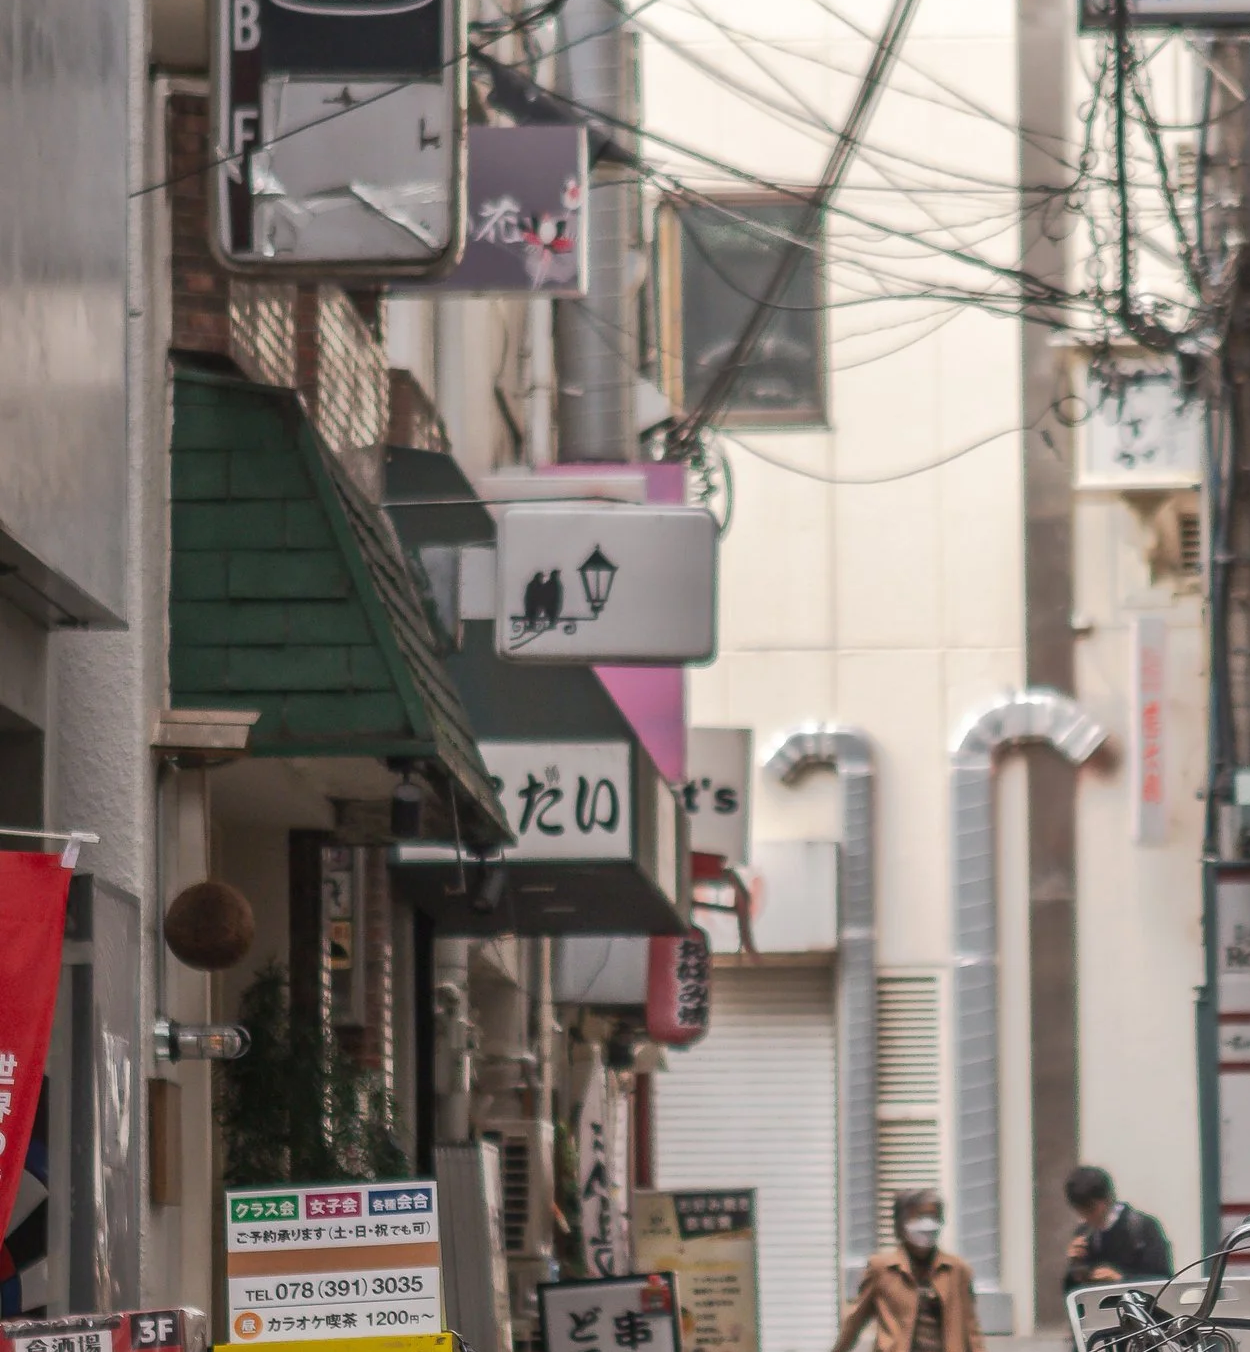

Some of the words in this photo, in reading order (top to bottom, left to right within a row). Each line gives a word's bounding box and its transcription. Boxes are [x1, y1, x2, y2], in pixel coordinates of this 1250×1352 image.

[235, 1200, 295, 1219] クラス会
[309, 1197, 358, 1216] 女子会
[372, 1193, 429, 1213] 各種会合
[246, 1290, 274, 1302] TEL
[139, 1318, 174, 1344] 3F
[268, 1313, 358, 1332] カラオケ喫茶
